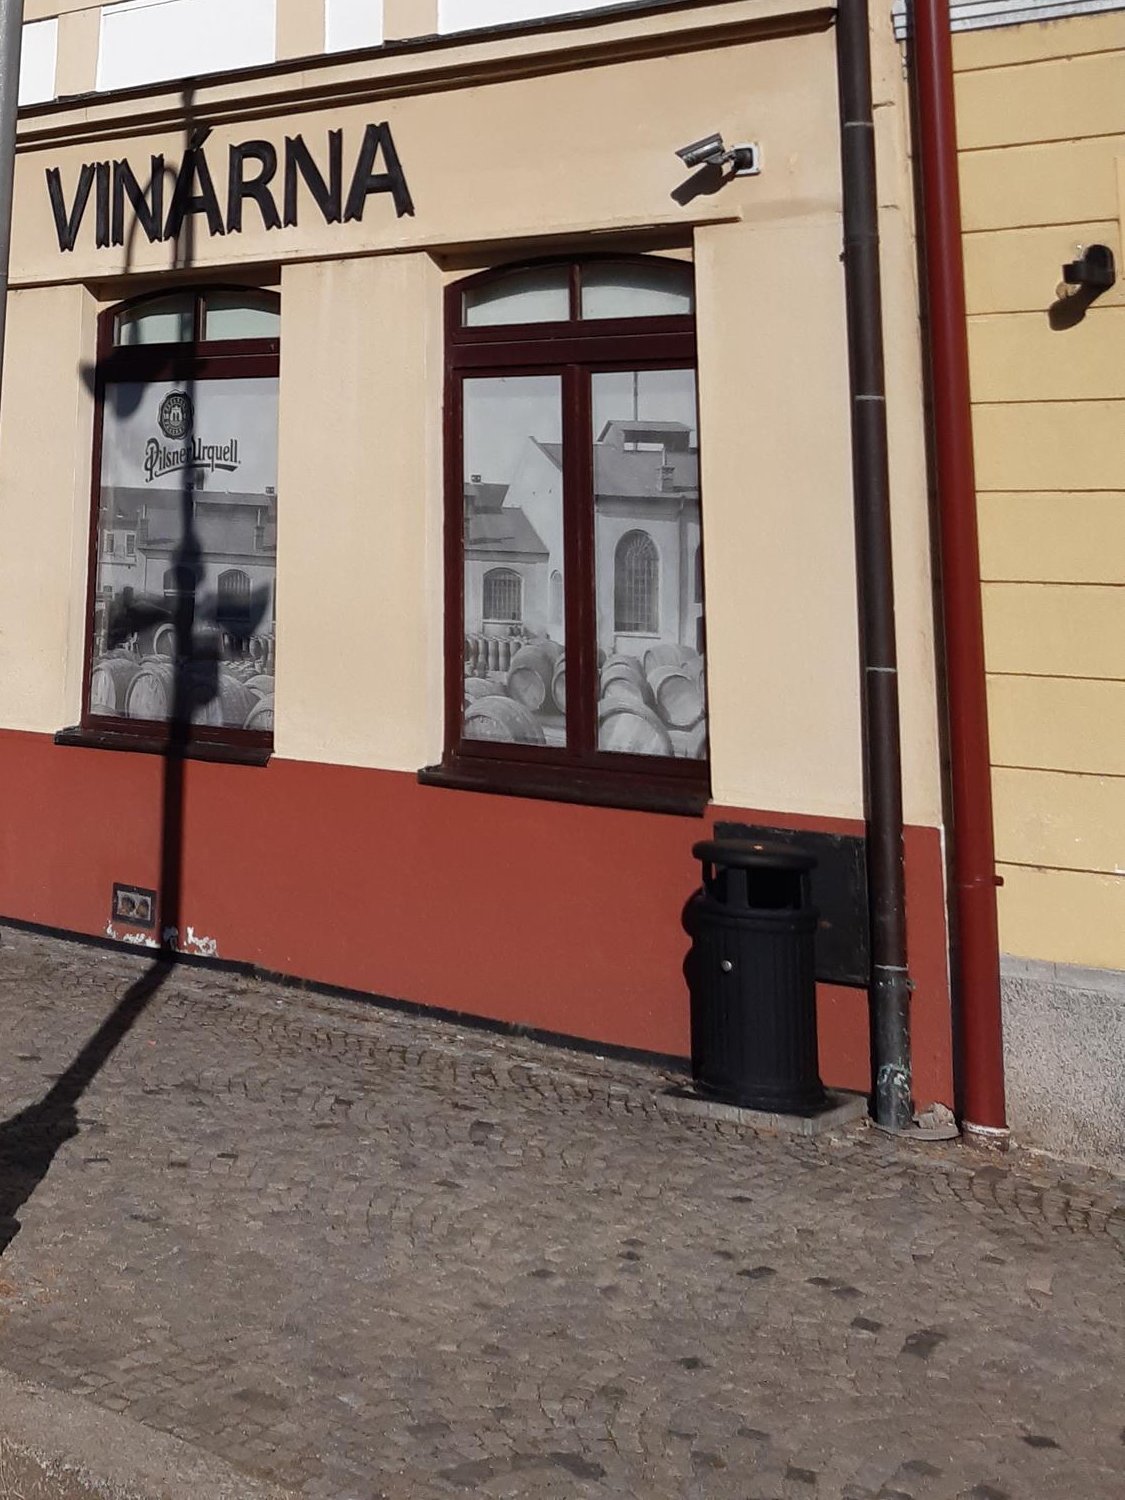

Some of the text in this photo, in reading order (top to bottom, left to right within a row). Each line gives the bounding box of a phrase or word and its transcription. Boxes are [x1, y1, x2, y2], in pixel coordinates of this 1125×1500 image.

[45, 121, 415, 253] VINÁRNA
[144, 435, 238, 483] Pilsner Urquell
